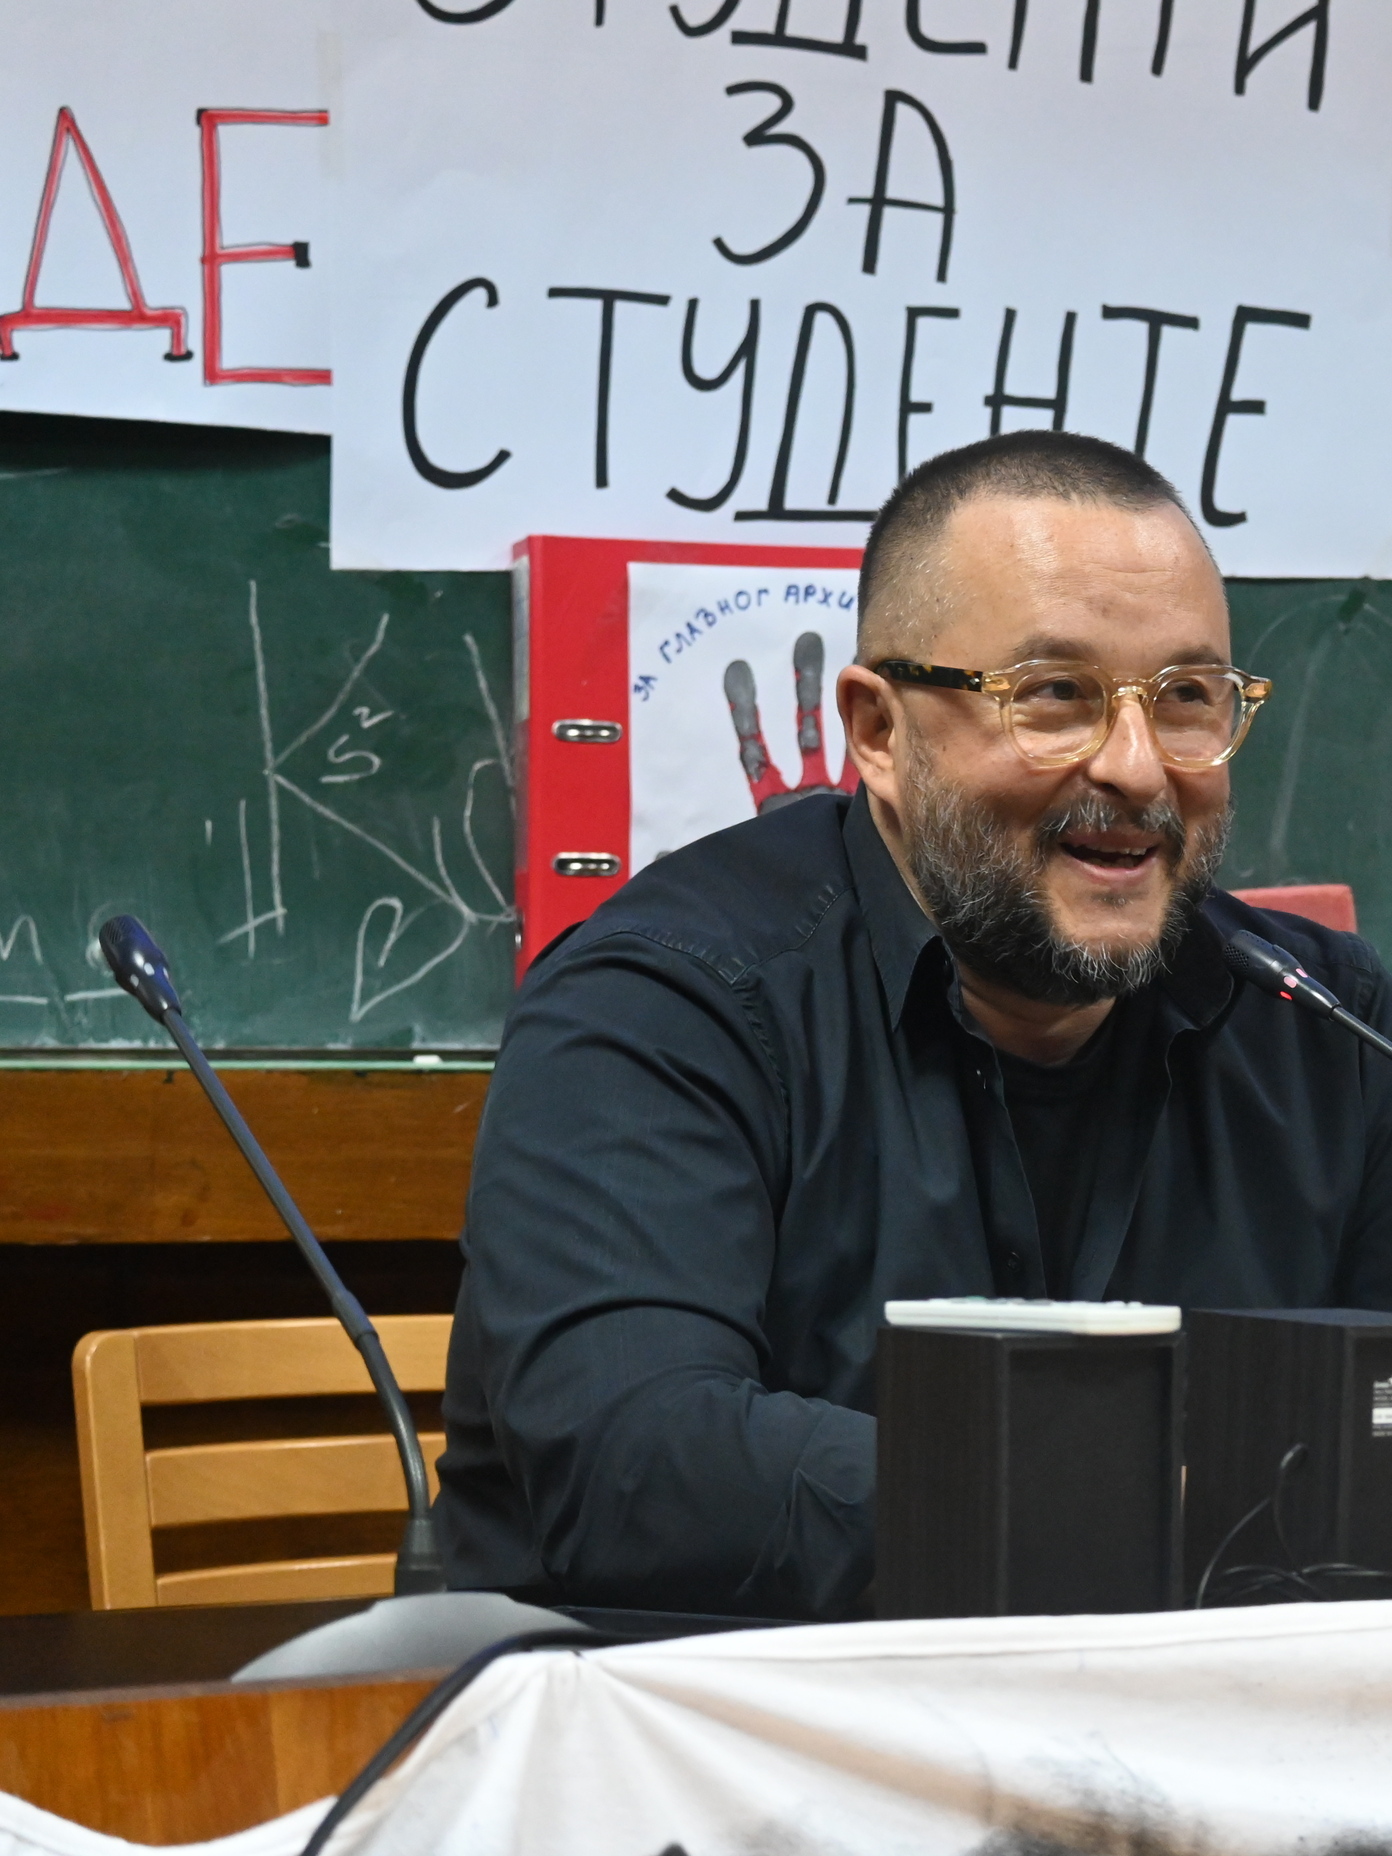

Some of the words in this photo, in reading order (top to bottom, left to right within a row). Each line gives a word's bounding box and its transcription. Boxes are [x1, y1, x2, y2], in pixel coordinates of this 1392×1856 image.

[712, 80, 955, 282] ЗА
[402, 277, 1312, 528] СТУДЕНТЕ
[657, 587, 771, 664] ГЛАВНОГ
